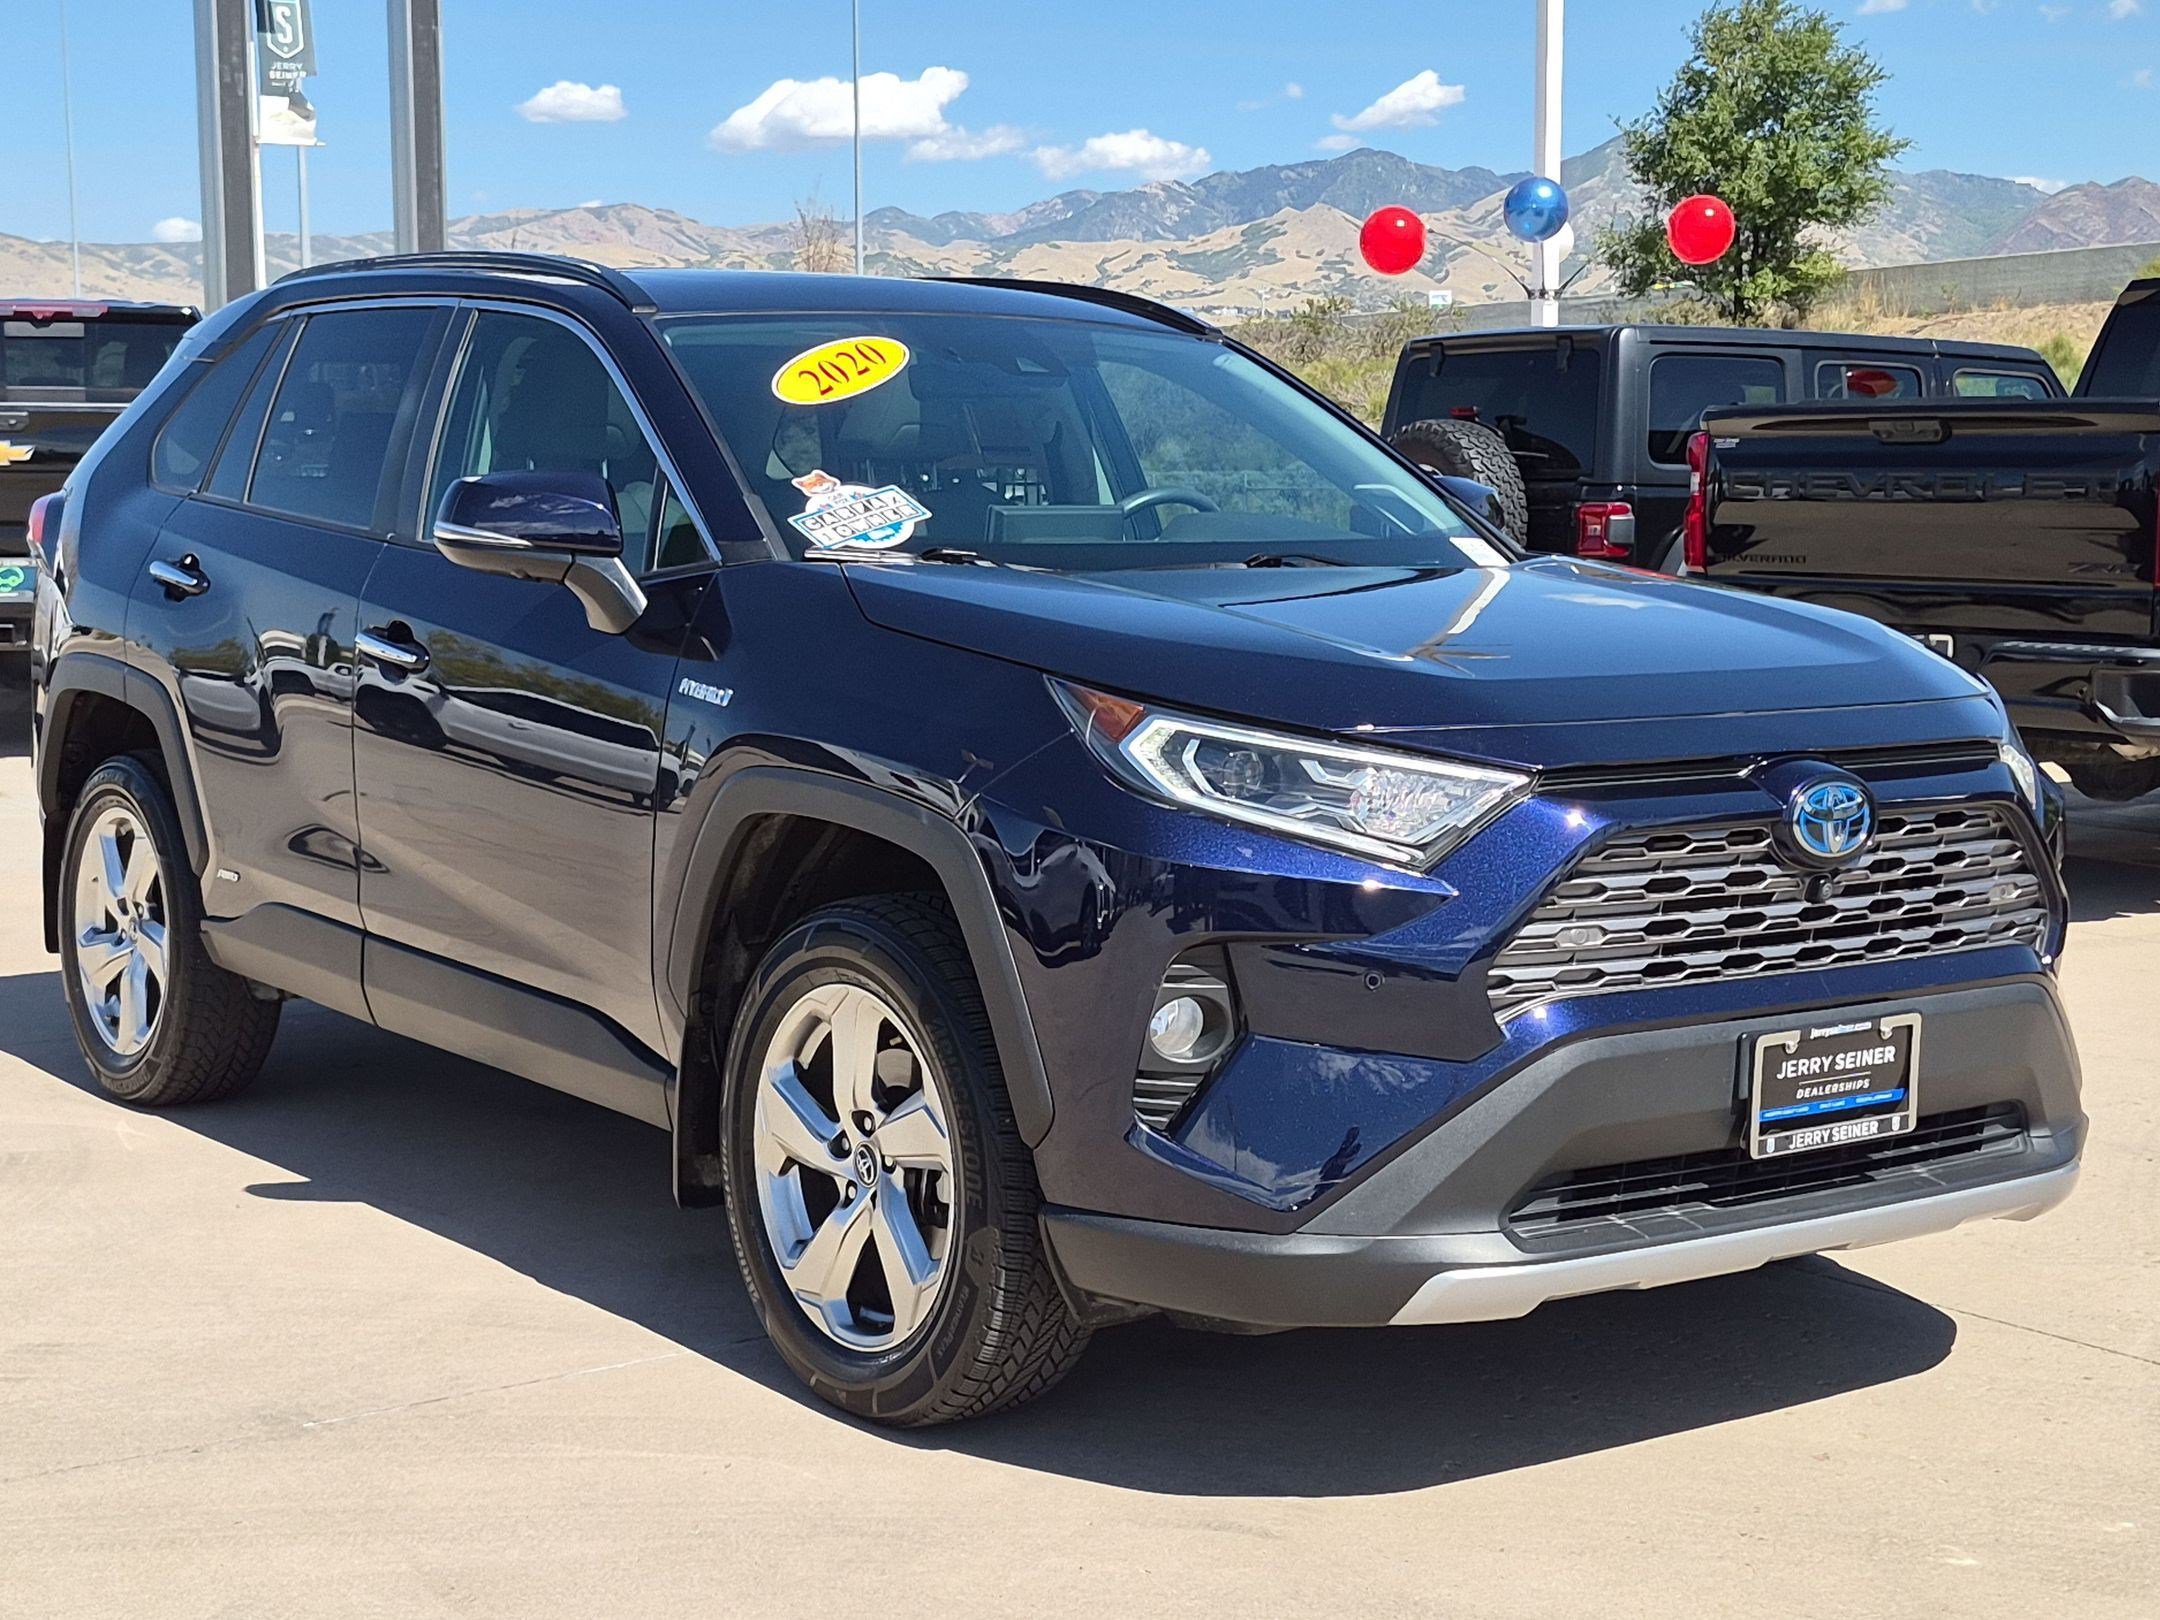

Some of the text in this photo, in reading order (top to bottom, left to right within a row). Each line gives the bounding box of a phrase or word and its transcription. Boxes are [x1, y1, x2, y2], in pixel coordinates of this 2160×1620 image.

[798, 342, 887, 396] 2020
[1727, 471, 2121, 500] CHEVROLET
[802, 495, 902, 532] CARFAX
[832, 503, 919, 538] OWNER
[1776, 1045, 1896, 1080] JERRY SEINER
[1796, 1078, 1871, 1100] DEALERSHIPS
[1789, 1120, 1880, 1150] JERRY SEINER
